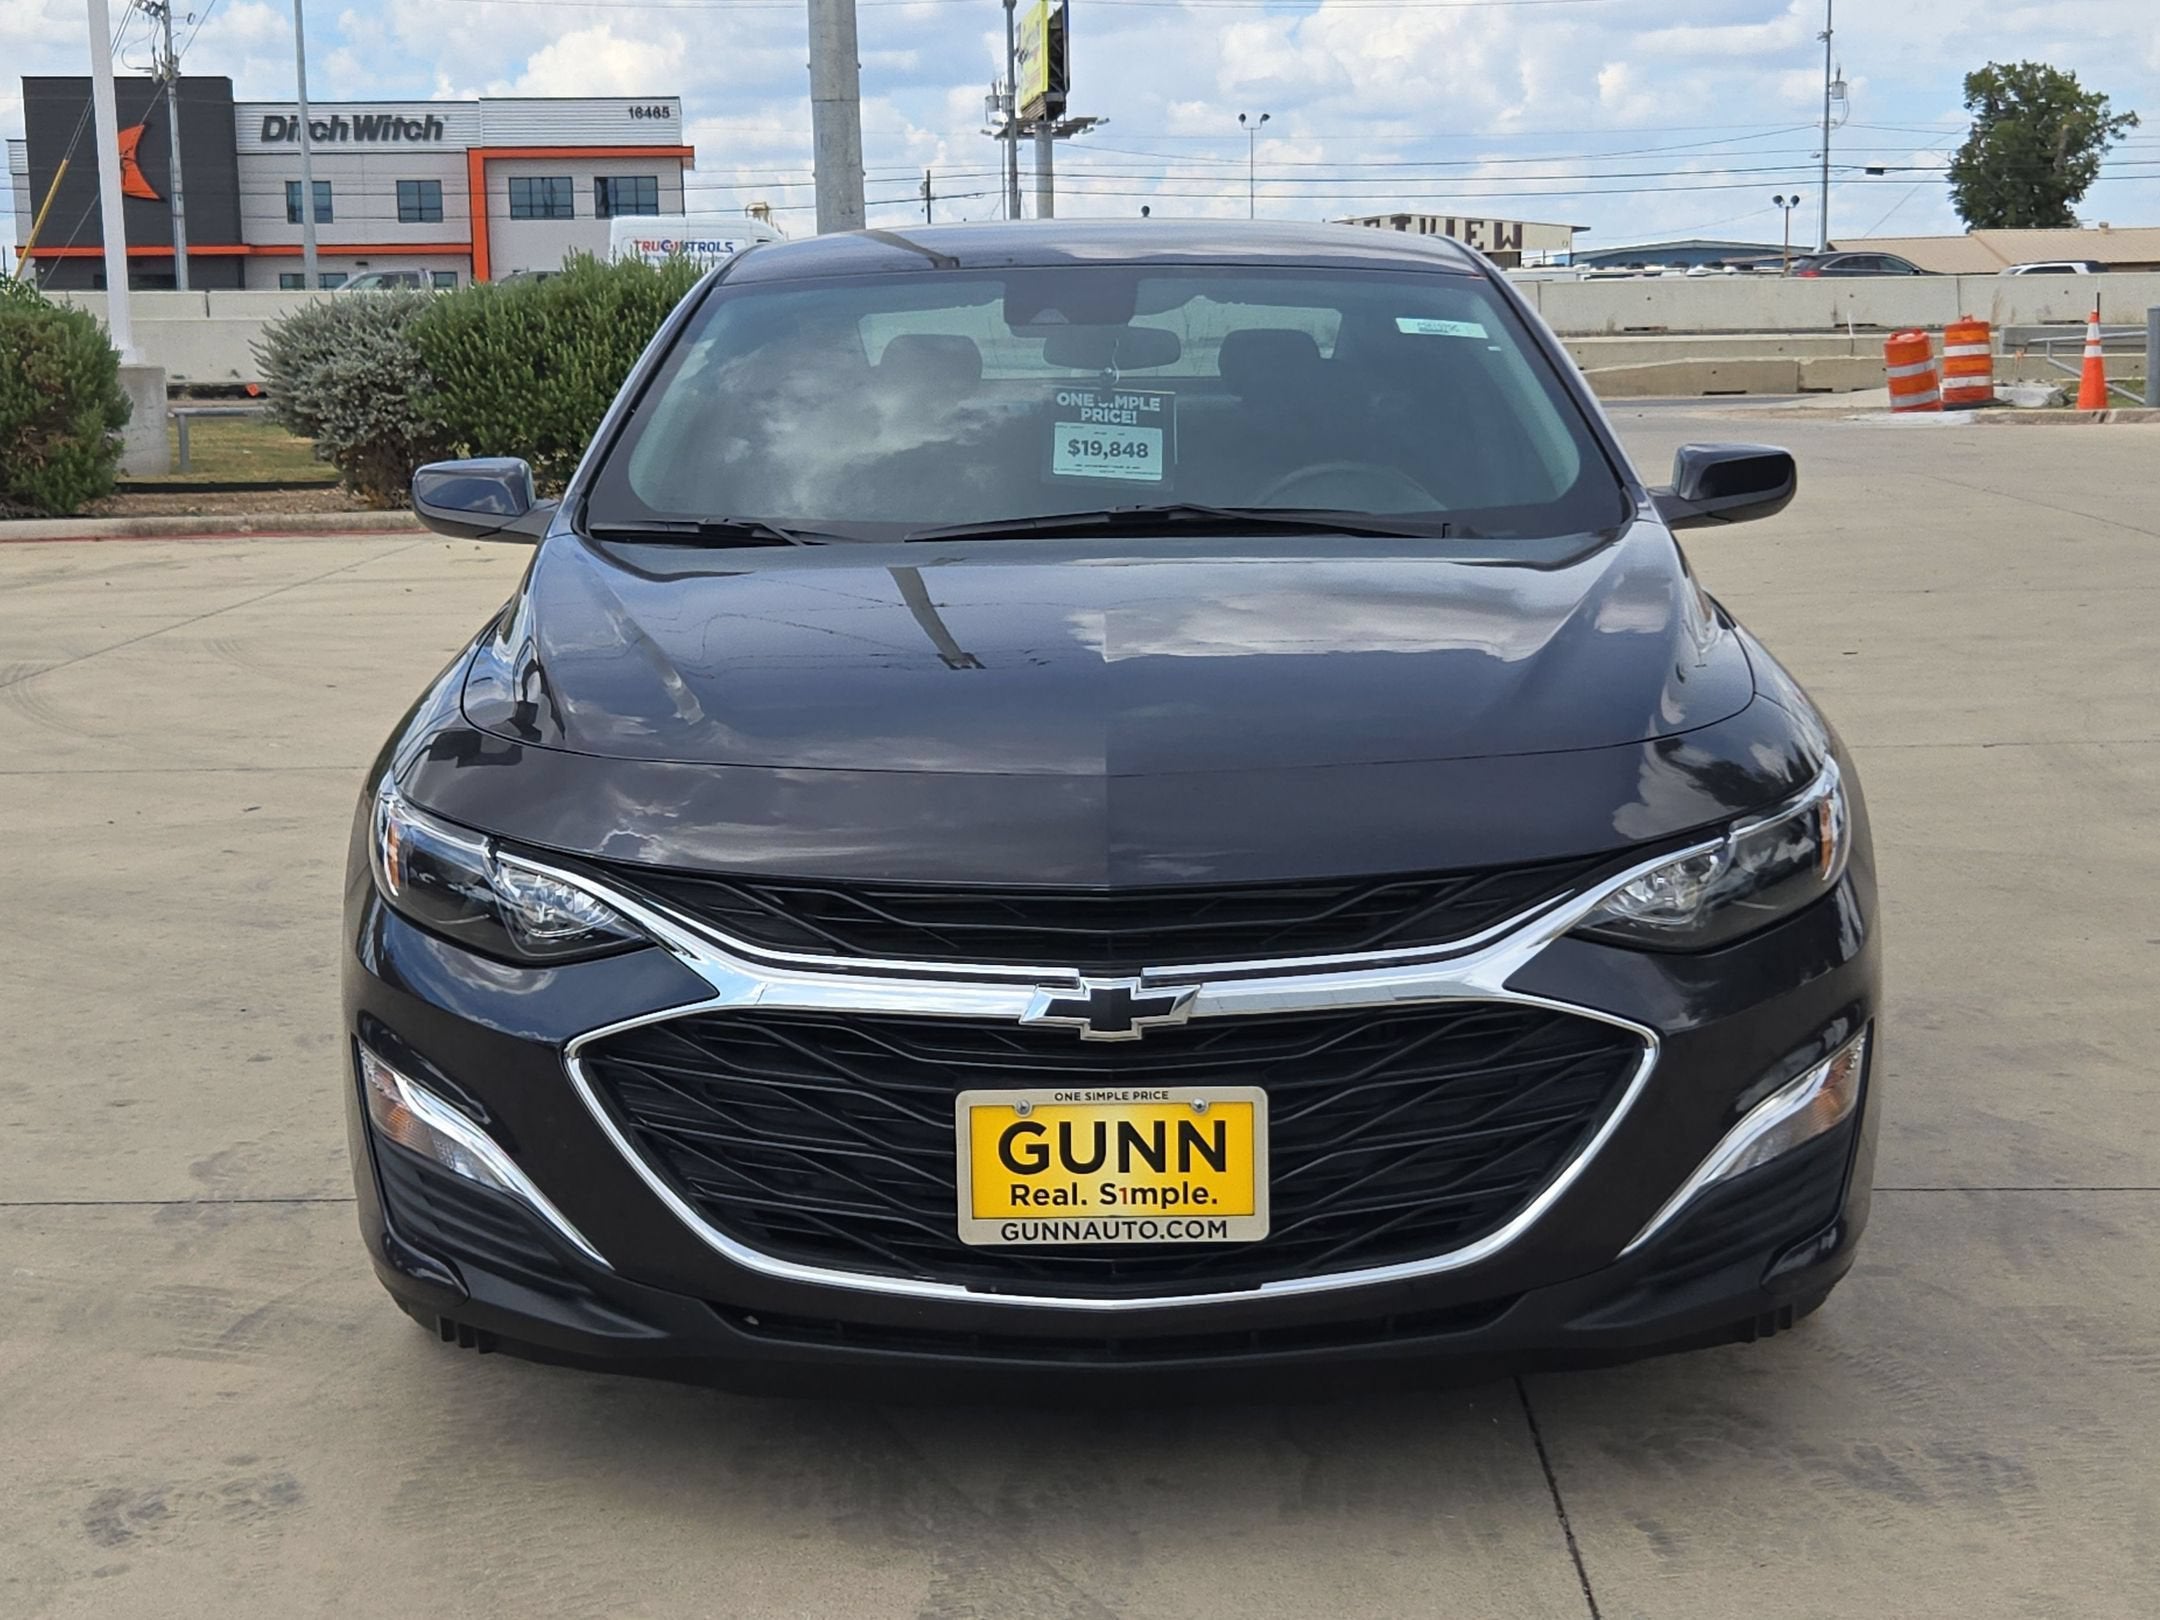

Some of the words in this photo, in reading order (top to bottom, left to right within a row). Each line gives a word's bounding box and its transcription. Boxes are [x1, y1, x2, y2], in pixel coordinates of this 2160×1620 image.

[628, 105, 671, 120] 16465
[352, 114, 444, 142] Witch
[1056, 391, 1095, 407] ONE
[1098, 393, 1161, 412] MPLE
[1081, 407, 1137, 424] PRICE!
[1067, 438, 1149, 460] $19,848
[1054, 1091, 1081, 1102] ONE
[1085, 1090, 1130, 1102] SIMPLE
[1133, 1090, 1169, 1101] PRICE
[998, 1120, 1227, 1175] GUNN
[1010, 1182, 1087, 1206] Real.
[1000, 1219, 1227, 1242] GUNNAUTO.COM
